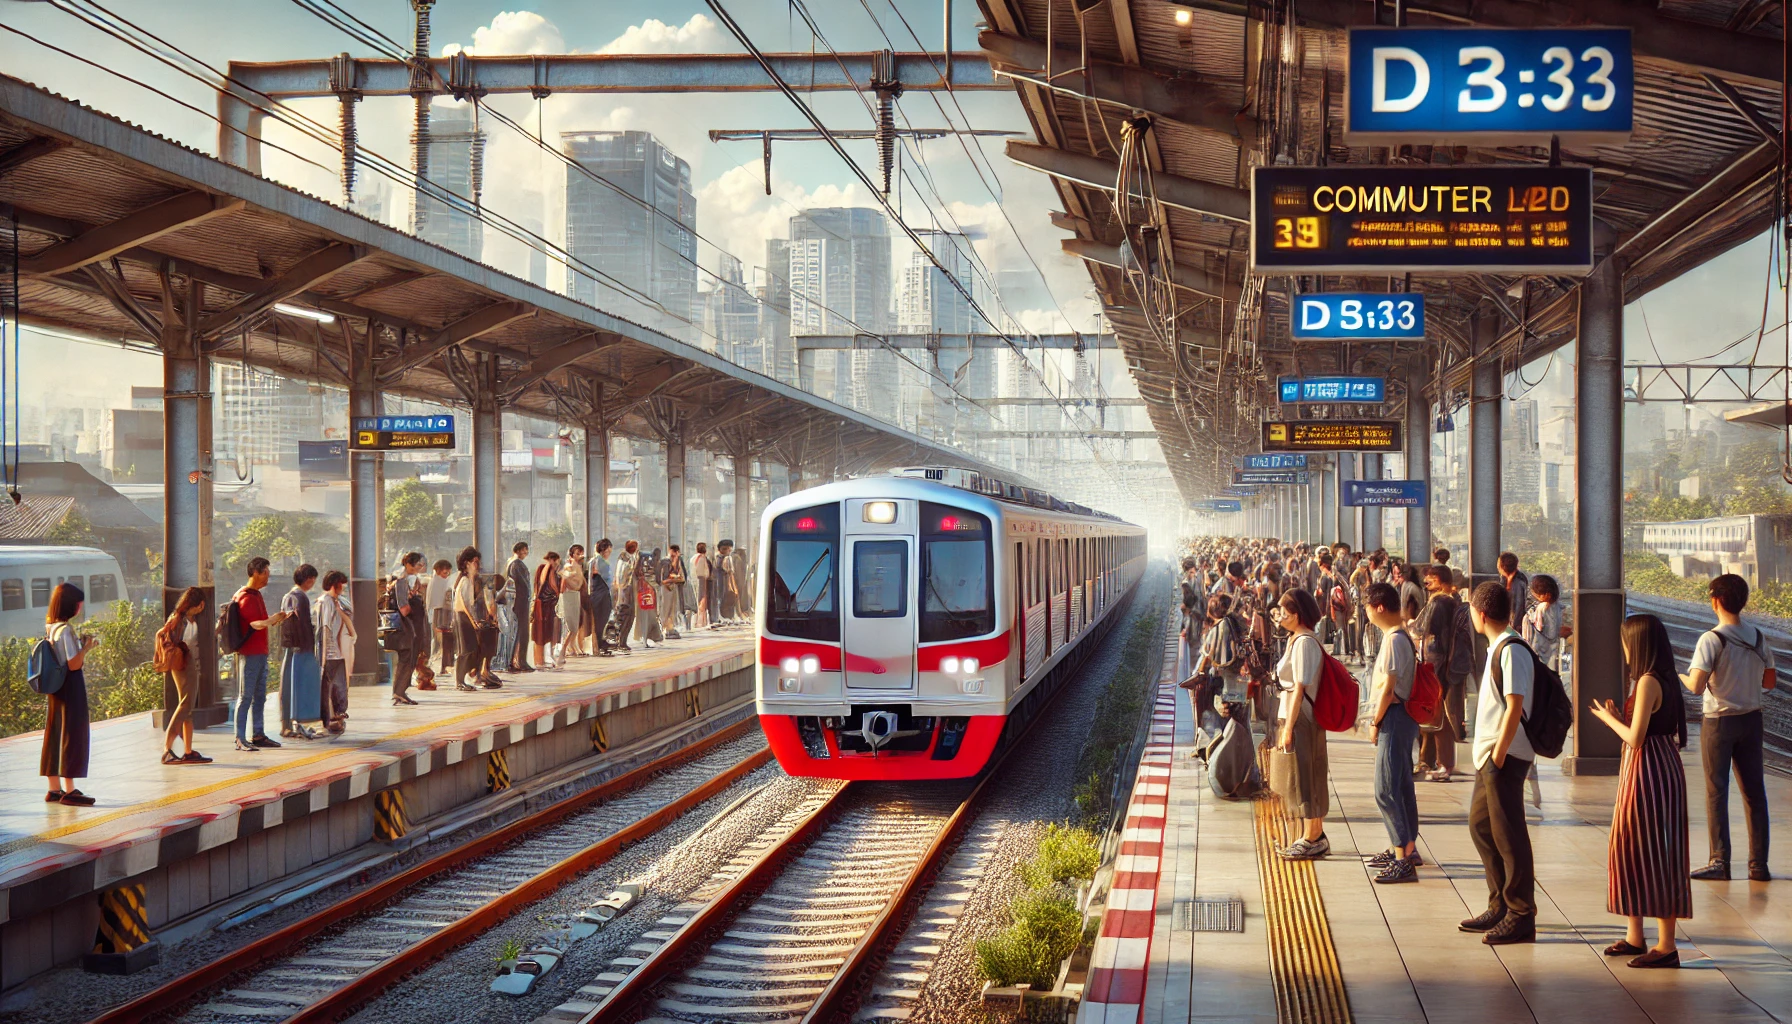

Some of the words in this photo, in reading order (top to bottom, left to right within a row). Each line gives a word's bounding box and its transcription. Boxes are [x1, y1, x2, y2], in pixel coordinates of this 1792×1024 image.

[1372, 47, 1430, 113] D
[1458, 46, 1616, 113] 3:33
[1313, 185, 1492, 213] COMMUTER
[1301, 300, 1331, 331] D
